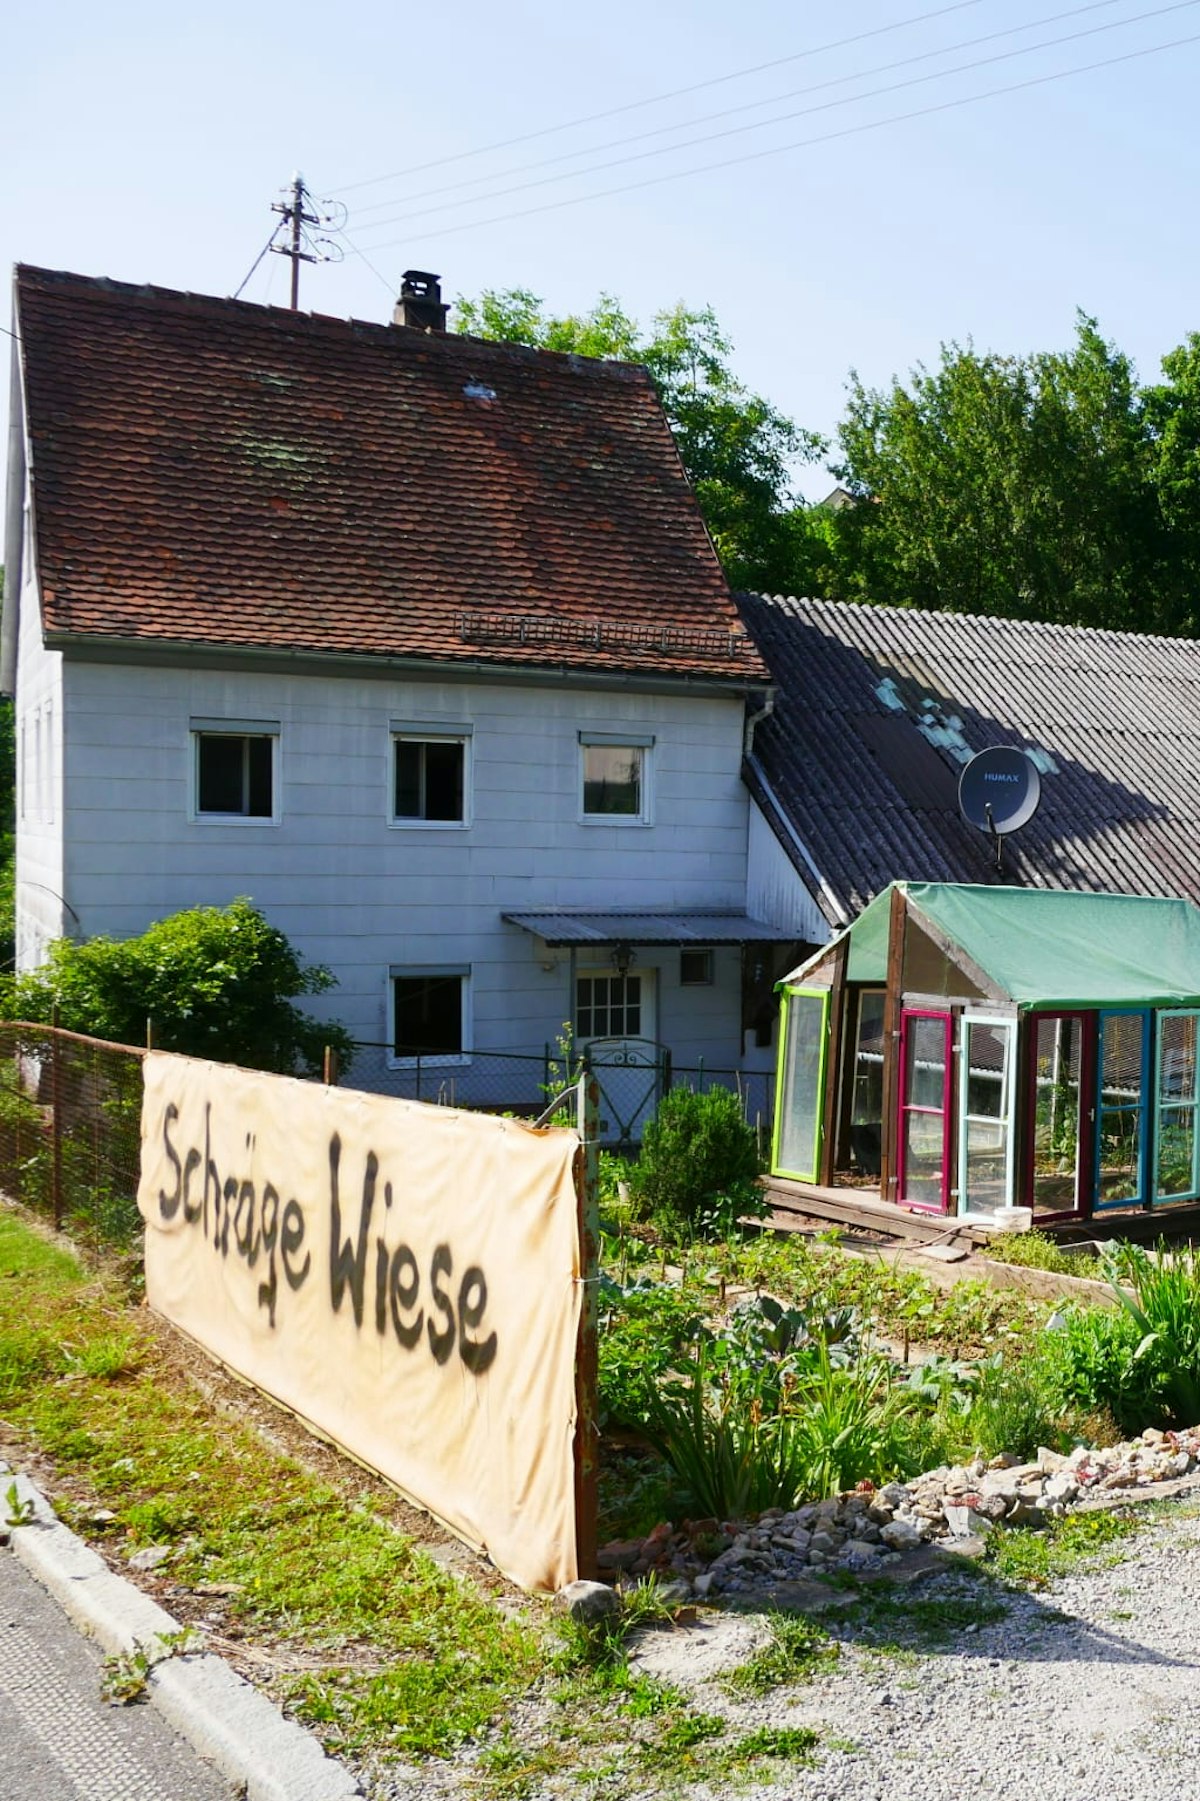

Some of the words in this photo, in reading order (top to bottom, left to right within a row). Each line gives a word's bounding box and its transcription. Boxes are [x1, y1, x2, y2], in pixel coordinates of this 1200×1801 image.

[984, 772, 1020, 783] HUMAX
[159, 1102, 310, 1330] Schräge
[328, 1130, 498, 1375] Wiese
